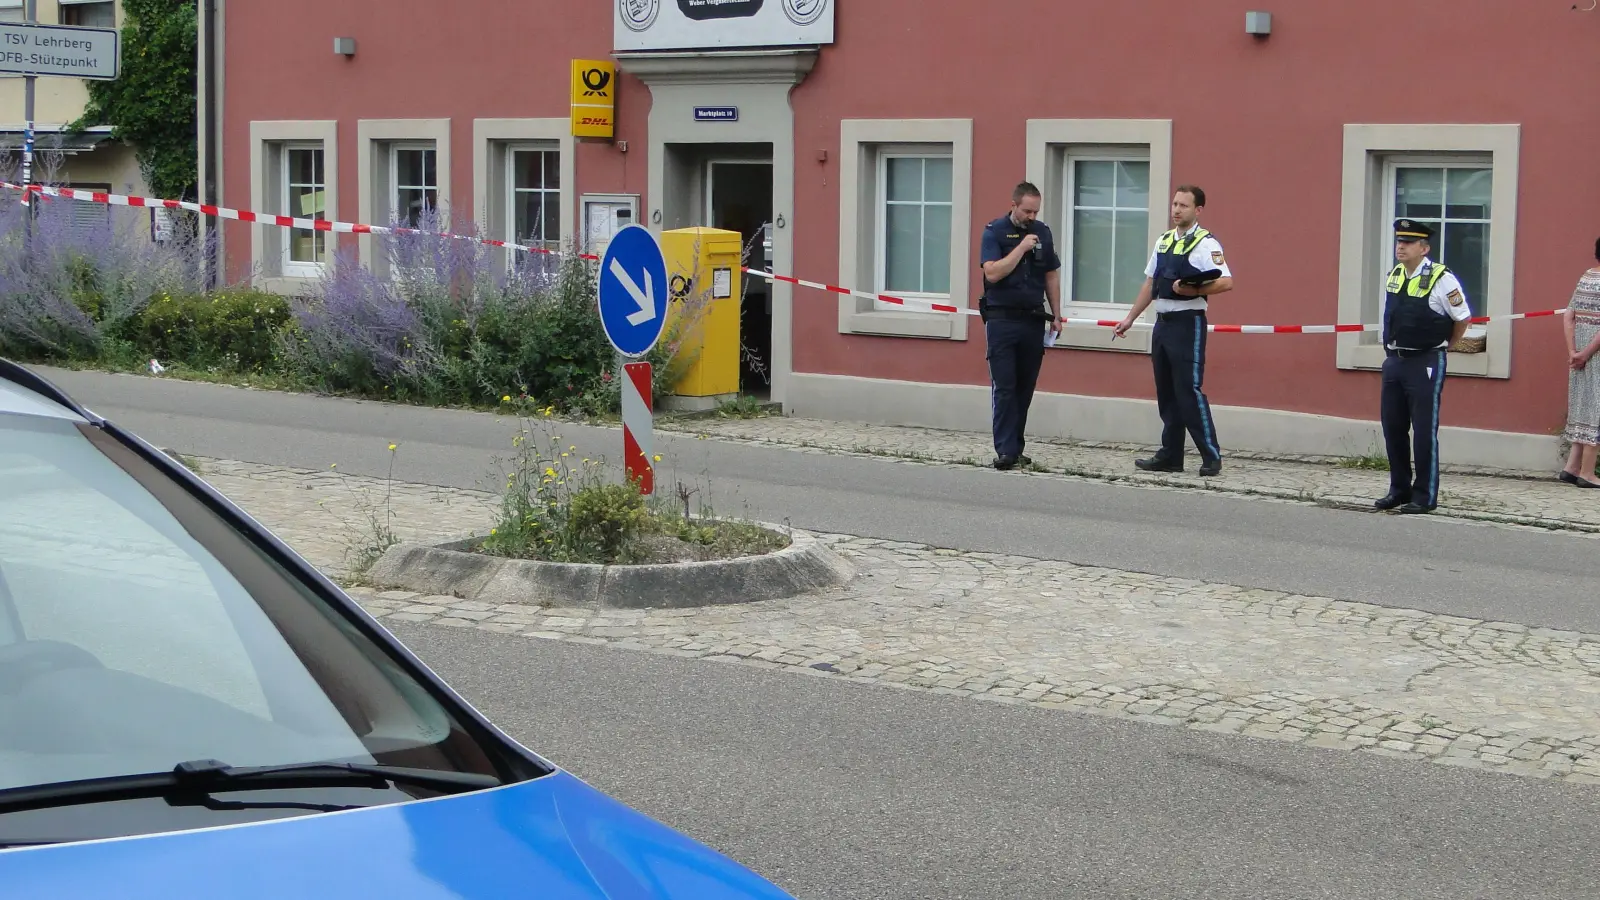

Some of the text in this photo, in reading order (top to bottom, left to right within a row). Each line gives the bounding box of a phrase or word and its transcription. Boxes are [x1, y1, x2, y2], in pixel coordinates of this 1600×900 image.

[5, 33, 92, 52] TSV Lehrberg
[0, 51, 98, 68] DFB-Stützpunkt
[581, 117, 609, 126] DHL
